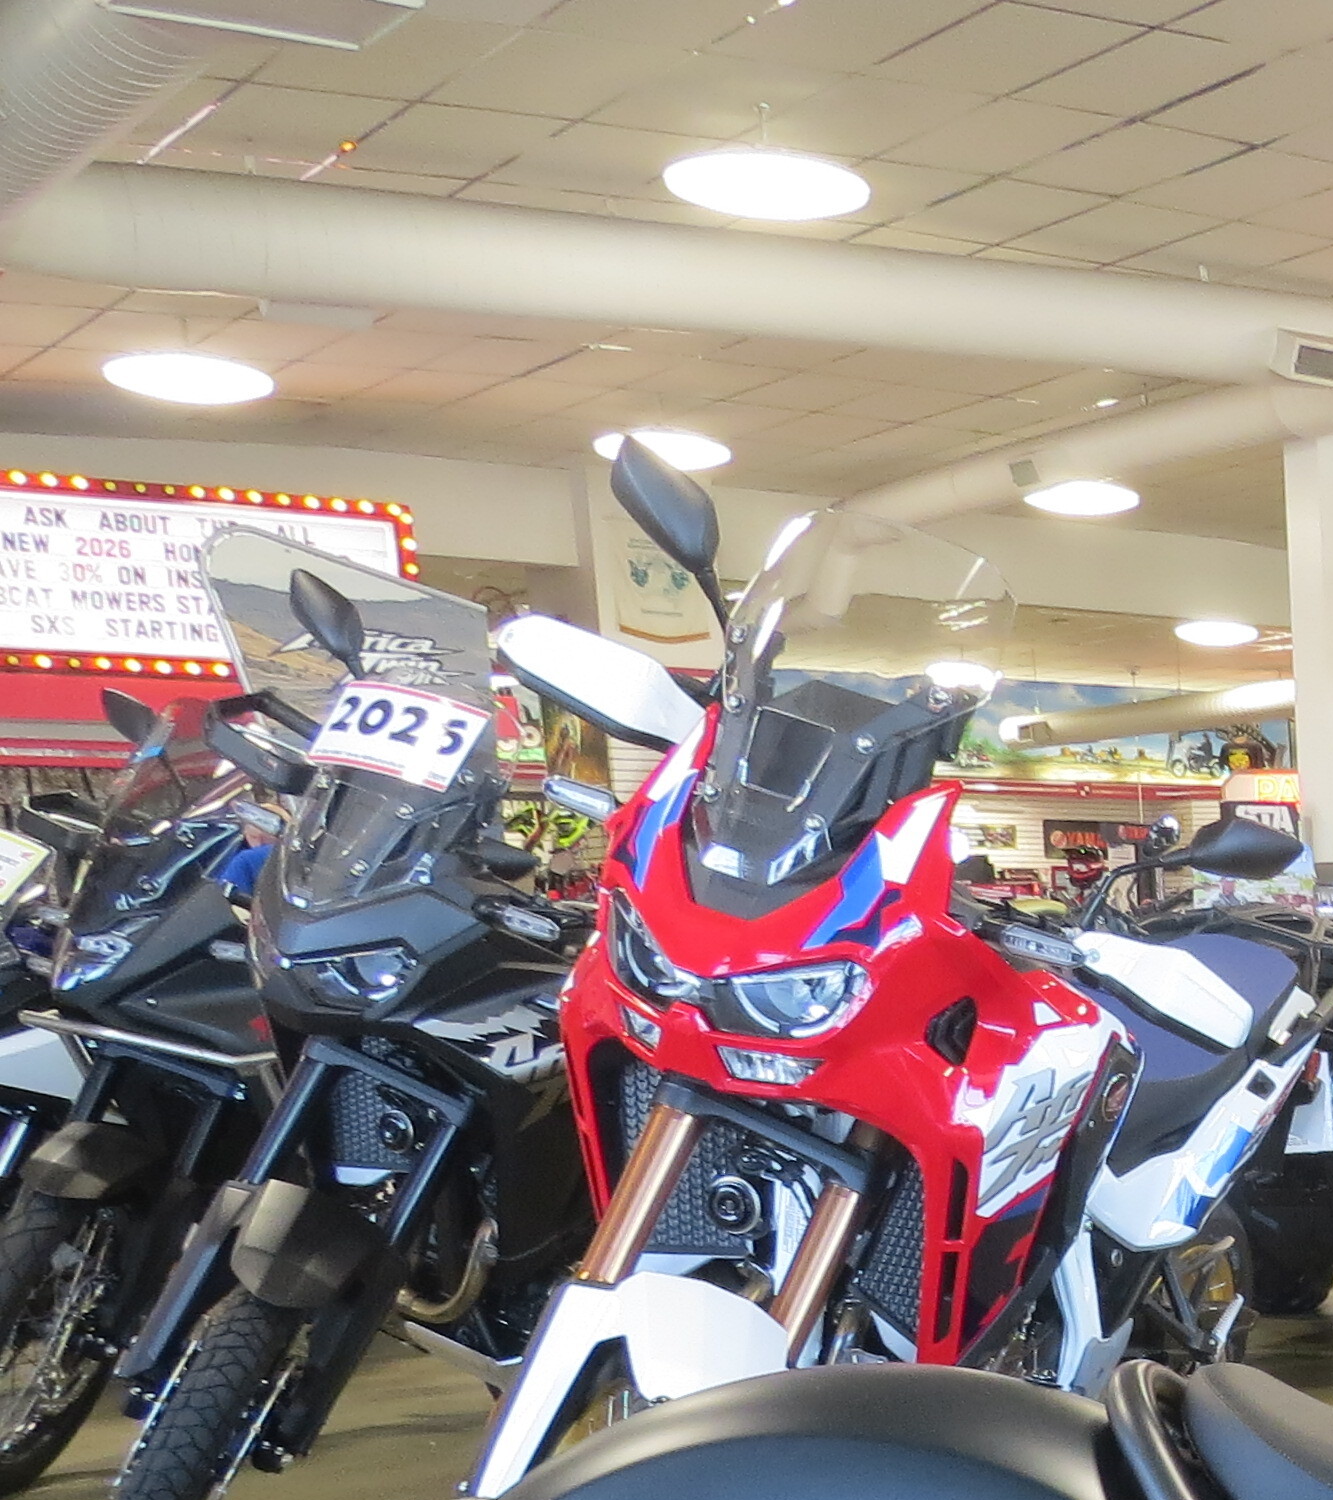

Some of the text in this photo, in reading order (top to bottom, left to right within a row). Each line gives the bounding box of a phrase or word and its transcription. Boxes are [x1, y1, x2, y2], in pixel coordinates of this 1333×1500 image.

[24, 506, 68, 528] ASK
[99, 511, 170, 535] ABOUT
[2, 531, 49, 554] NEW
[75, 537, 132, 558] 2026
[117, 566, 147, 585] ON
[71, 590, 166, 613] MOWERS
[31, 615, 220, 642] SXS STARTING
